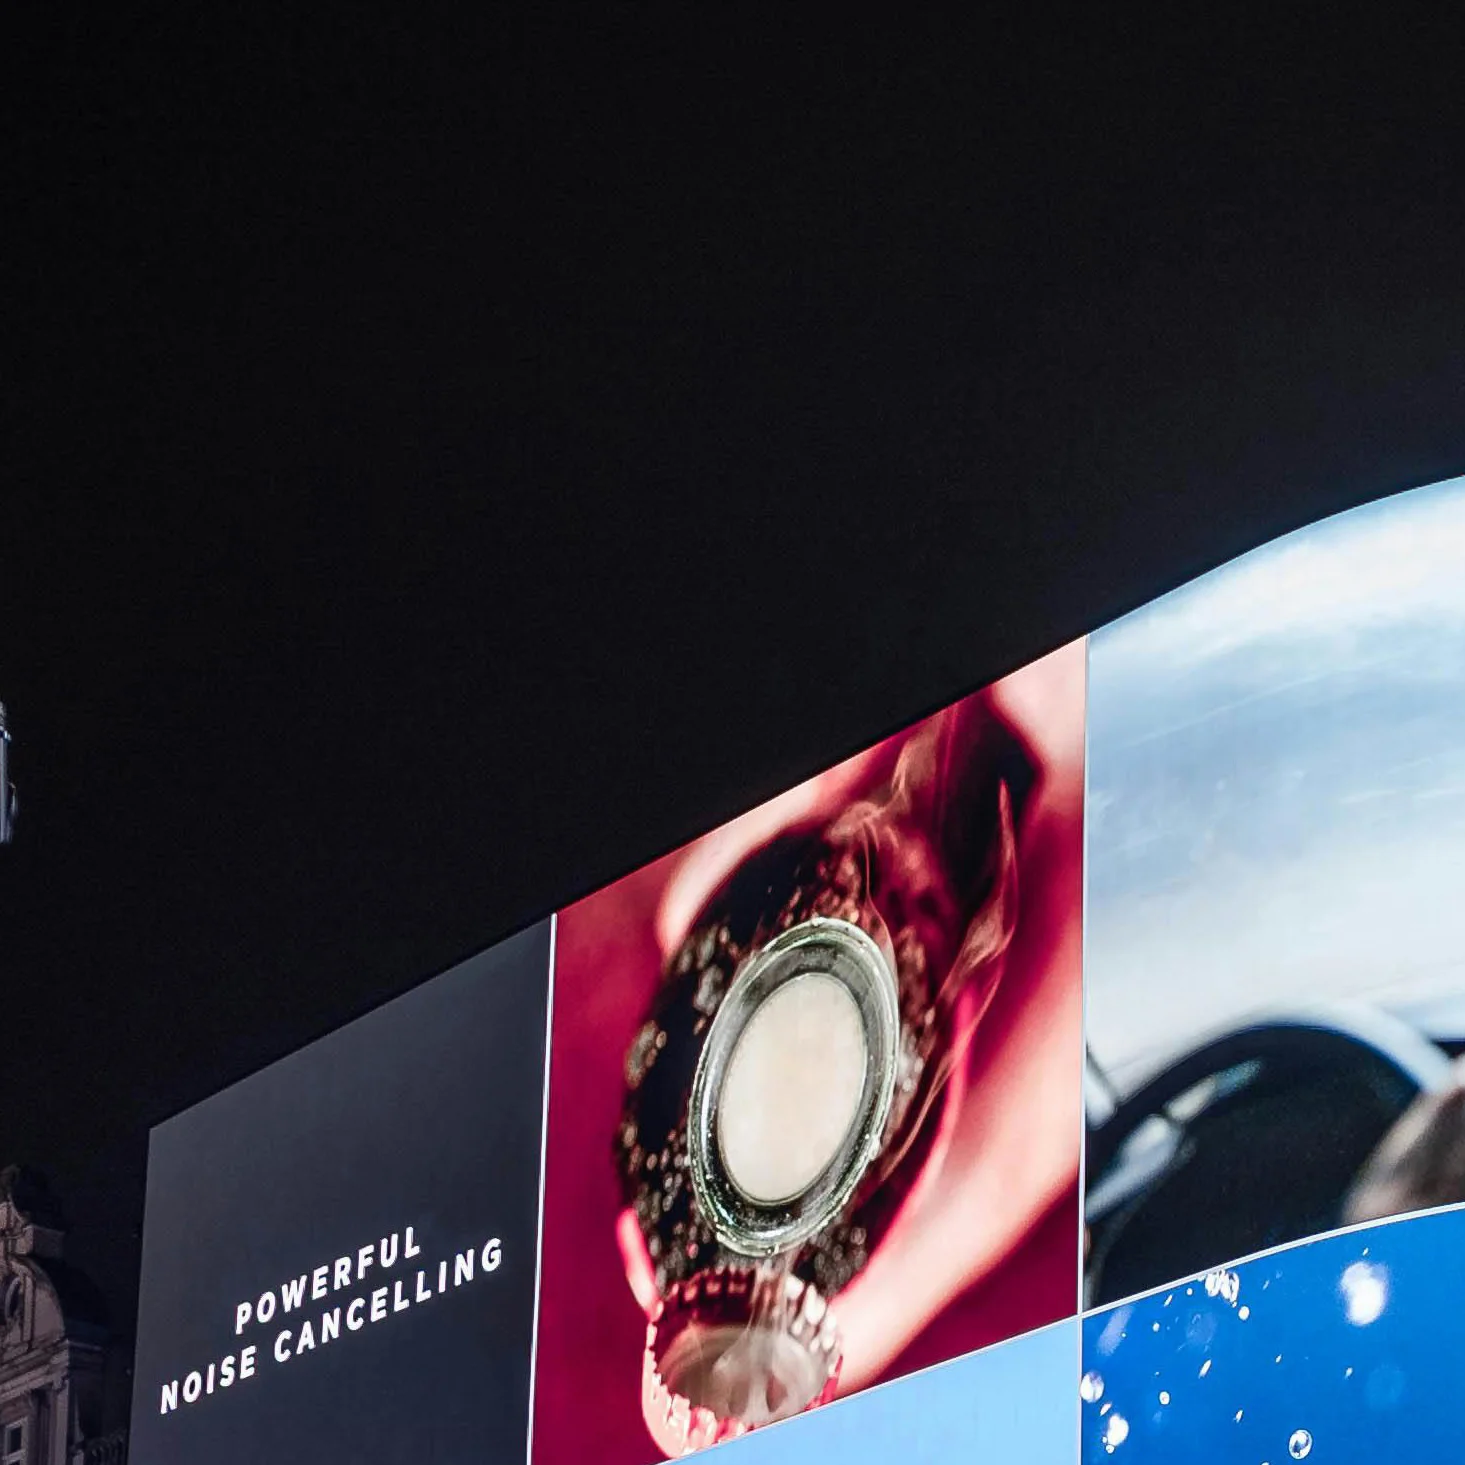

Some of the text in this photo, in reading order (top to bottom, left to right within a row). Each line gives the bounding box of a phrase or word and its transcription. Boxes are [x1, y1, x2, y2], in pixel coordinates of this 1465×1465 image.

[160, 1238, 501, 1414] NOISE CANCELLING
[235, 1226, 420, 1335] POWERFUL
